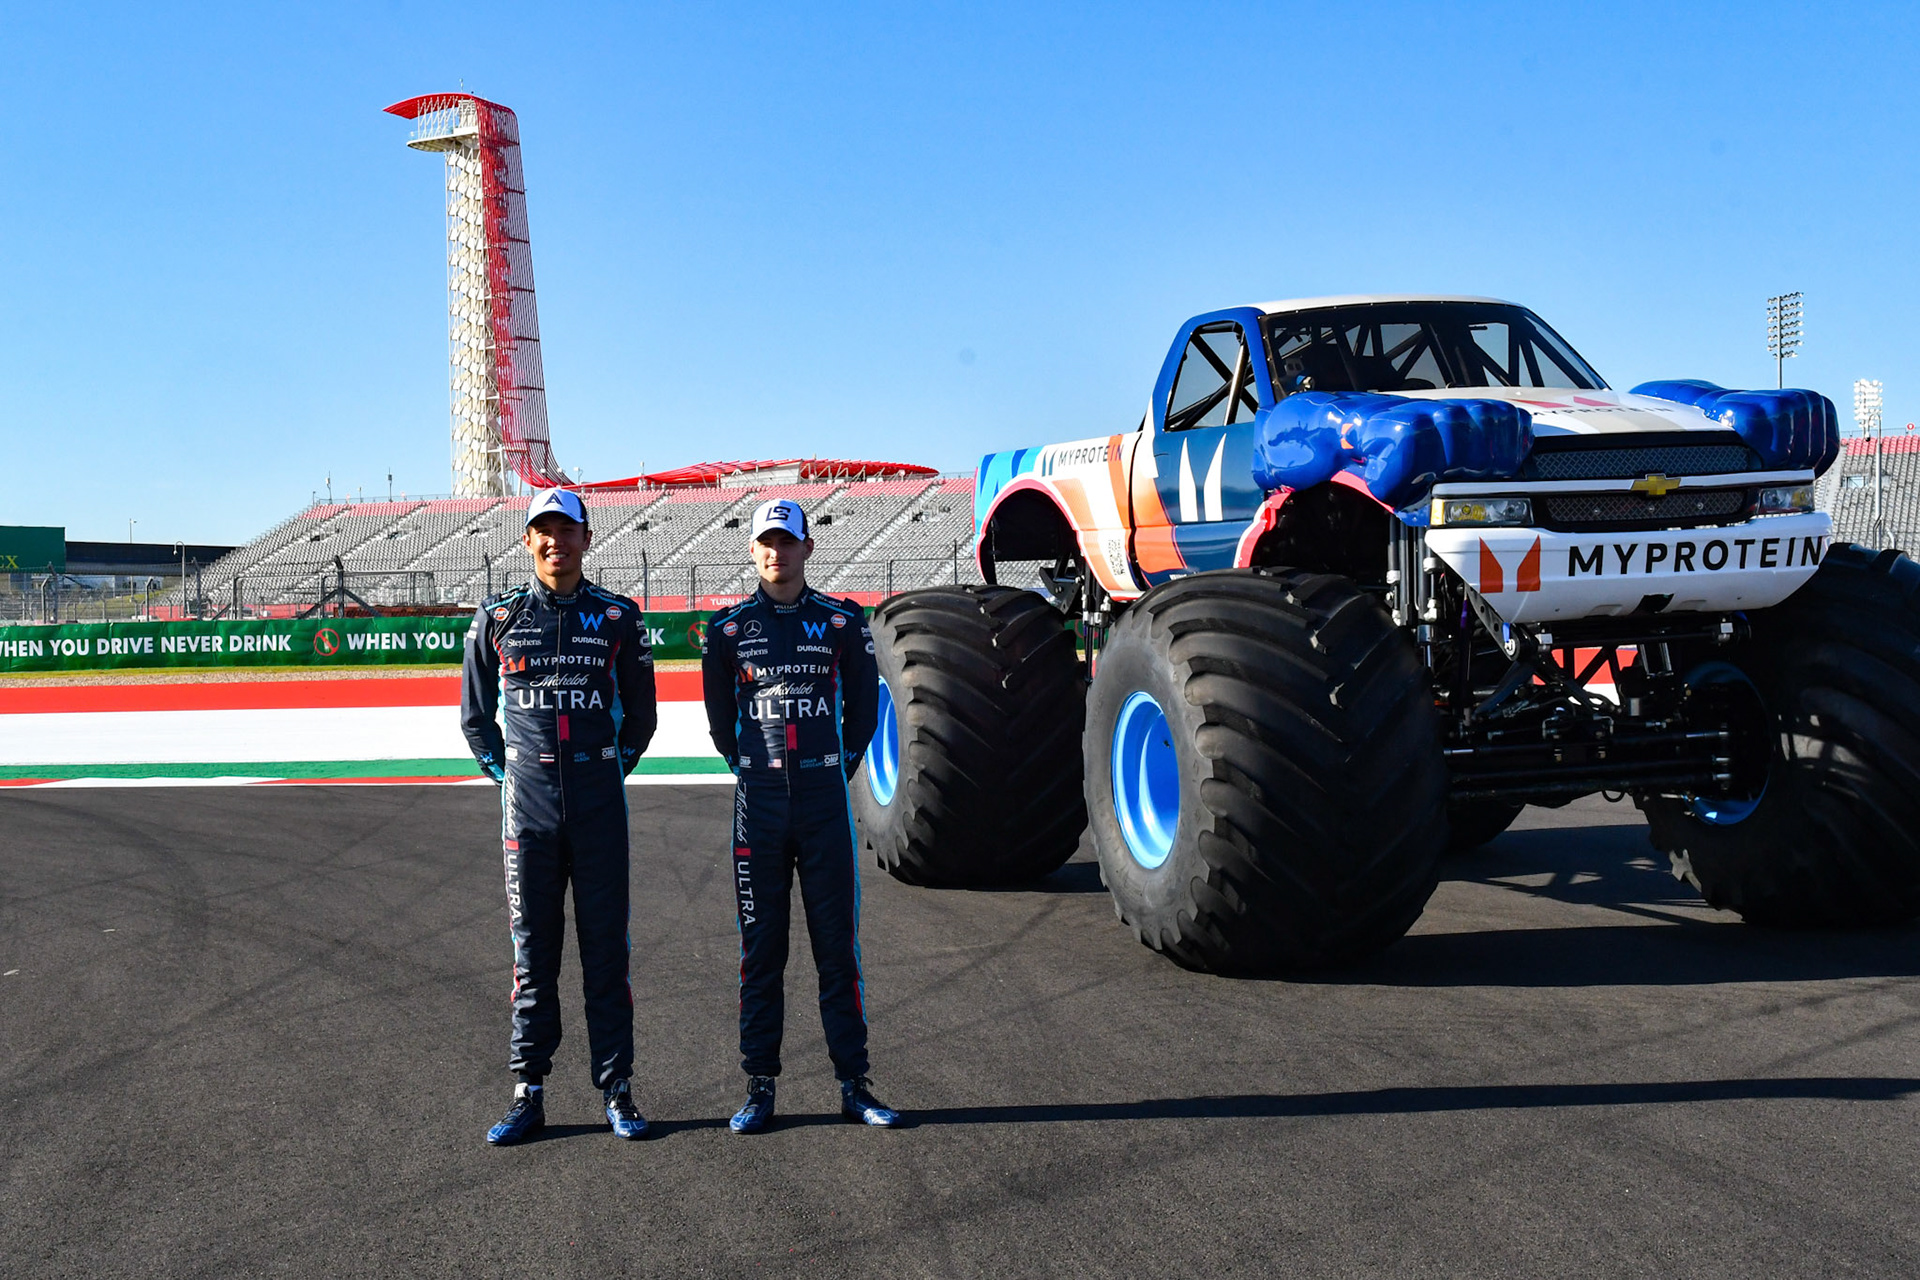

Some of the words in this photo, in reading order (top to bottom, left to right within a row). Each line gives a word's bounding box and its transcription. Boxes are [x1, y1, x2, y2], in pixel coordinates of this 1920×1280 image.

[1058, 444, 1124, 467] MYPROTEIN
[1567, 536, 1823, 577] MYPROTEIN
[711, 598, 735, 606] TURN
[0, 640, 43, 657] HEN
[49, 639, 89, 656] YOU
[97, 637, 153, 655] DRIVE
[161, 635, 223, 653] NEVER
[229, 634, 292, 652] DRINK
[346, 633, 406, 650] WHEN
[412, 632, 455, 650] YOU
[507, 638, 542, 648] Stephens
[571, 636, 609, 647] DURACELL
[737, 648, 768, 659] Stephens
[797, 645, 833, 655] DURACELL
[530, 655, 605, 668] MYPROTEIN
[755, 664, 830, 678] MYPROTEIN
[529, 672, 591, 688] Michelob
[758, 681, 816, 698] Michelob
[518, 689, 603, 710] ULTRA
[748, 696, 830, 720] ULTRA
[735, 776, 748, 844] Michelob
[506, 854, 522, 921] ULTRA
[737, 861, 756, 926] ULTRA
